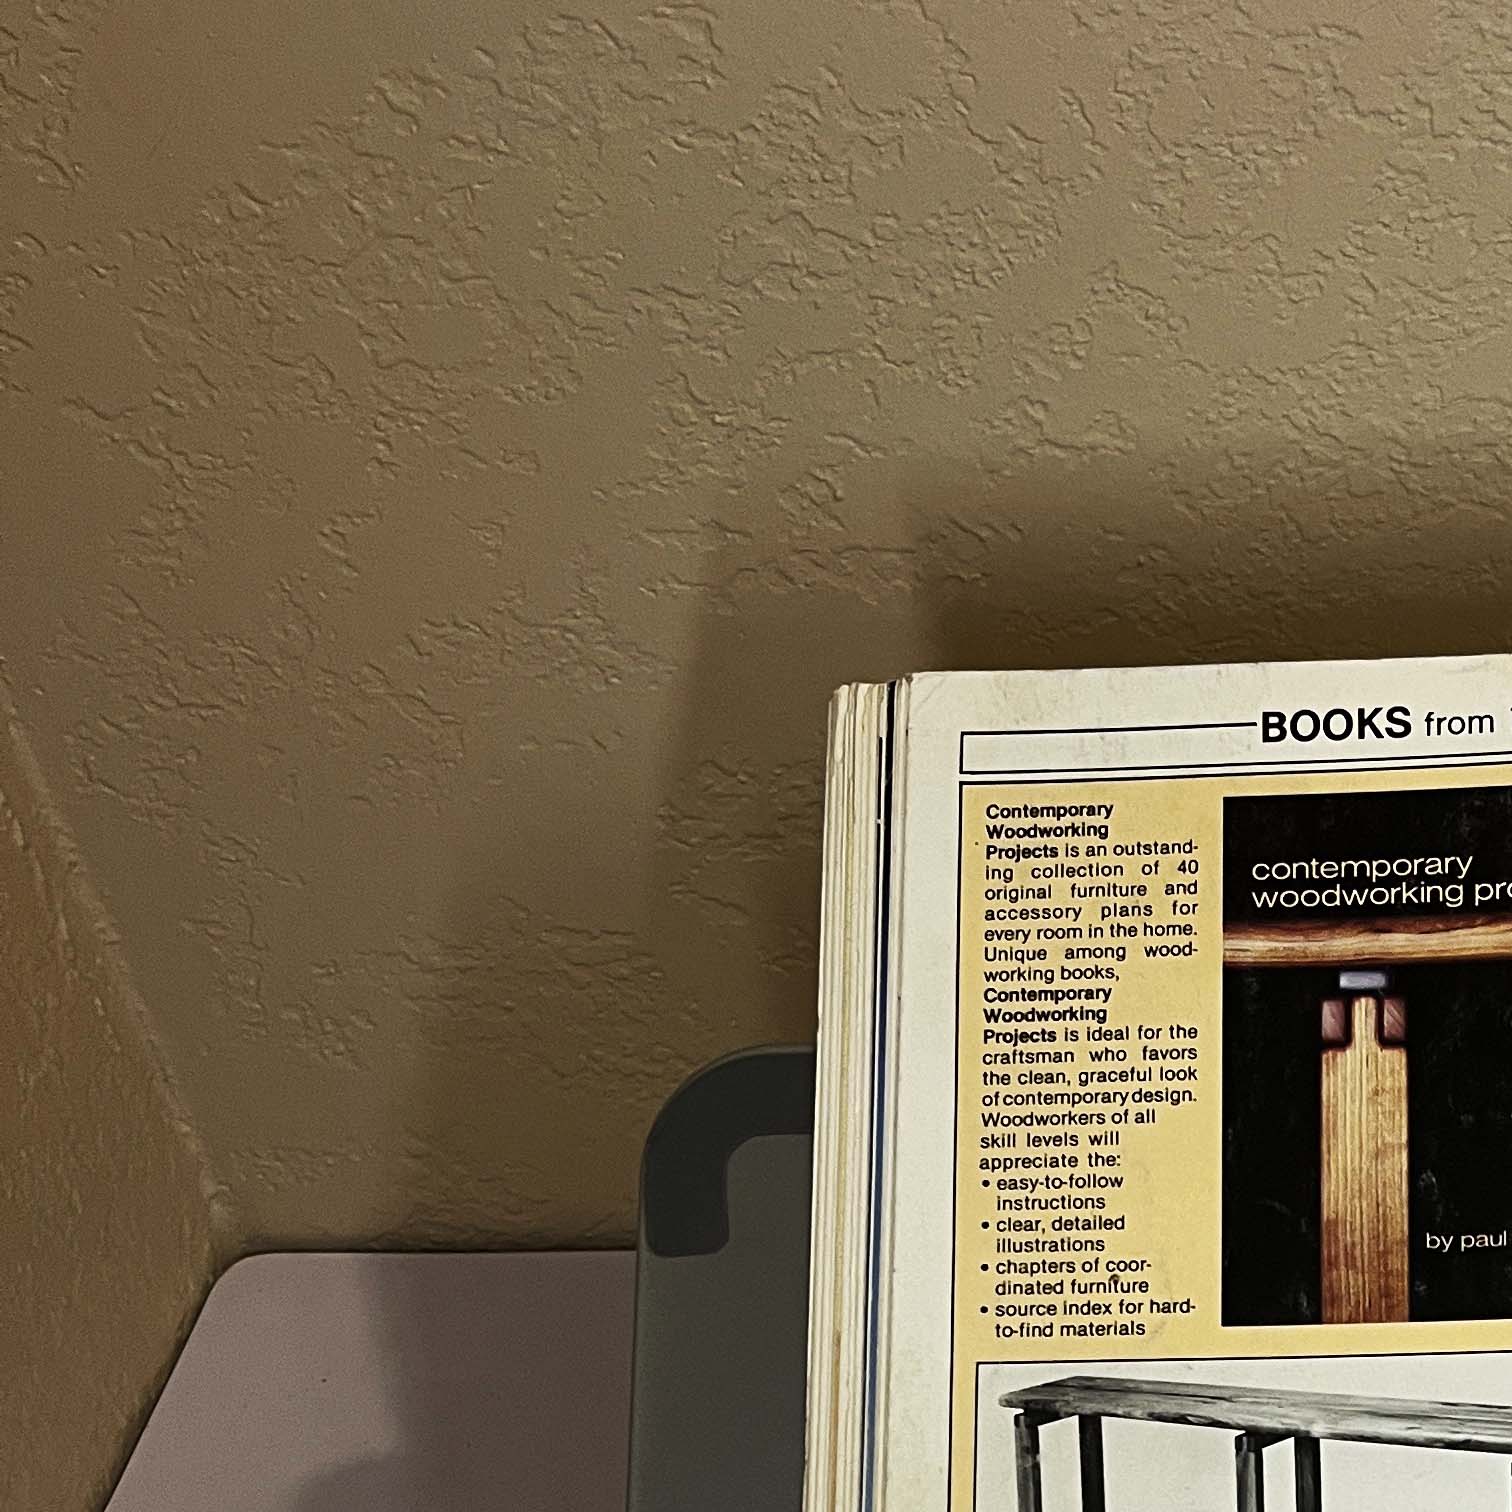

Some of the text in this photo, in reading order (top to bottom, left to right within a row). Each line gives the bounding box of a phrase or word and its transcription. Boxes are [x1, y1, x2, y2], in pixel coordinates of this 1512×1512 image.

[1262, 706, 1412, 743] BOOKS
[1424, 712, 1494, 736] from
[986, 804, 1114, 821] Contemporary
[986, 822, 1108, 840] Woodworking
[986, 838, 1198, 863] Projects is an outstand-
[986, 859, 1198, 883] ing collection of 40
[1252, 856, 1473, 882] contemporary
[985, 879, 1197, 904] original furniture and
[1252, 881, 1463, 908] woodworking
[984, 964, 1119, 984] working books,
[984, 988, 1112, 1005] Contemporary
[983, 1005, 1107, 1024] Woodworking
[981, 1108, 1155, 1127] Woodworkers of all
[979, 1152, 1121, 1173] appreciate the:
[997, 1173, 1123, 1194] easy-to-follow
[997, 1195, 1106, 1211] instructions
[996, 1215, 1125, 1234] clear, detailed
[997, 1237, 1105, 1253] illustrations
[1426, 1232, 1453, 1253] by
[1461, 1230, 1506, 1252] paul
[996, 1257, 1151, 1277] chapters of coor-
[995, 1298, 1196, 1317] source index for hard-
[995, 1320, 1145, 1338] to-find materials
